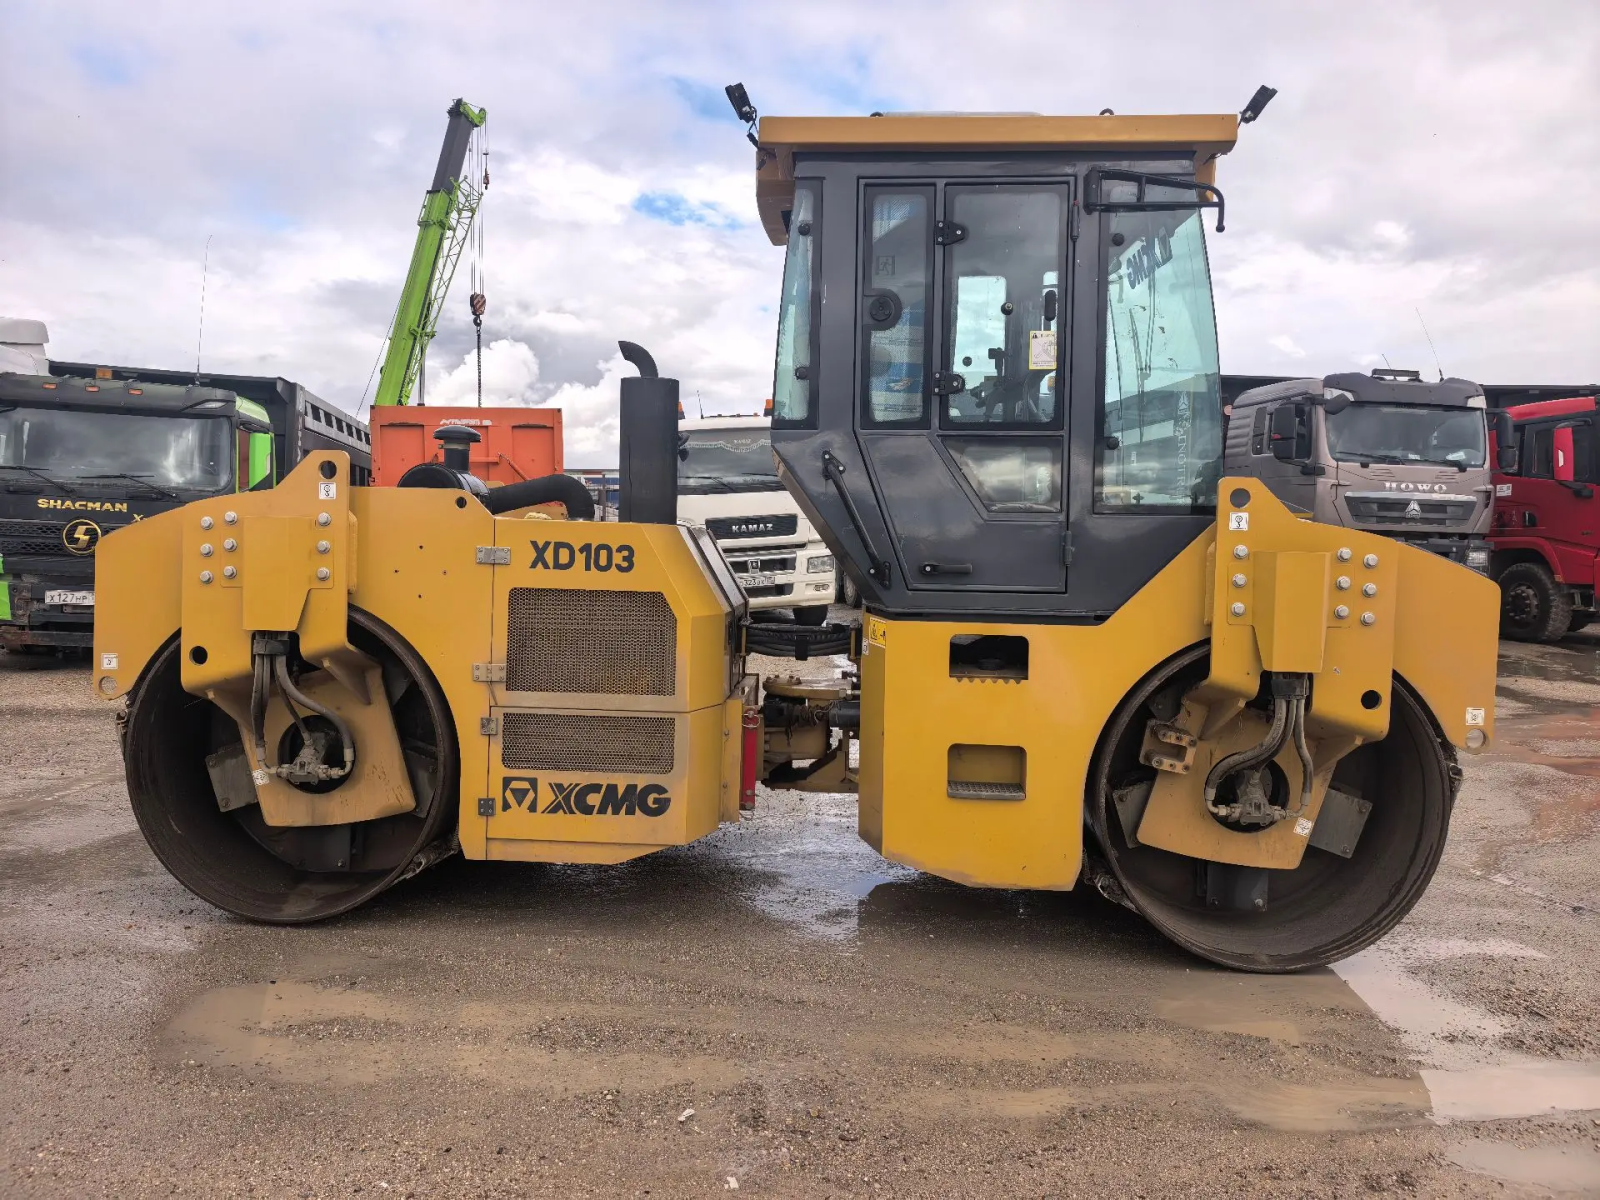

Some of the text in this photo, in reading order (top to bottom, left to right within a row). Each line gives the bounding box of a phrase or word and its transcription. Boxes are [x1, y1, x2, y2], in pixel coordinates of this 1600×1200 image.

[1384, 482, 1447, 493] HOWO
[37, 498, 128, 512] SHACMAN
[731, 523, 774, 533] KAMAZ
[529, 540, 635, 573] XD103
[541, 782, 672, 818] XCMG
